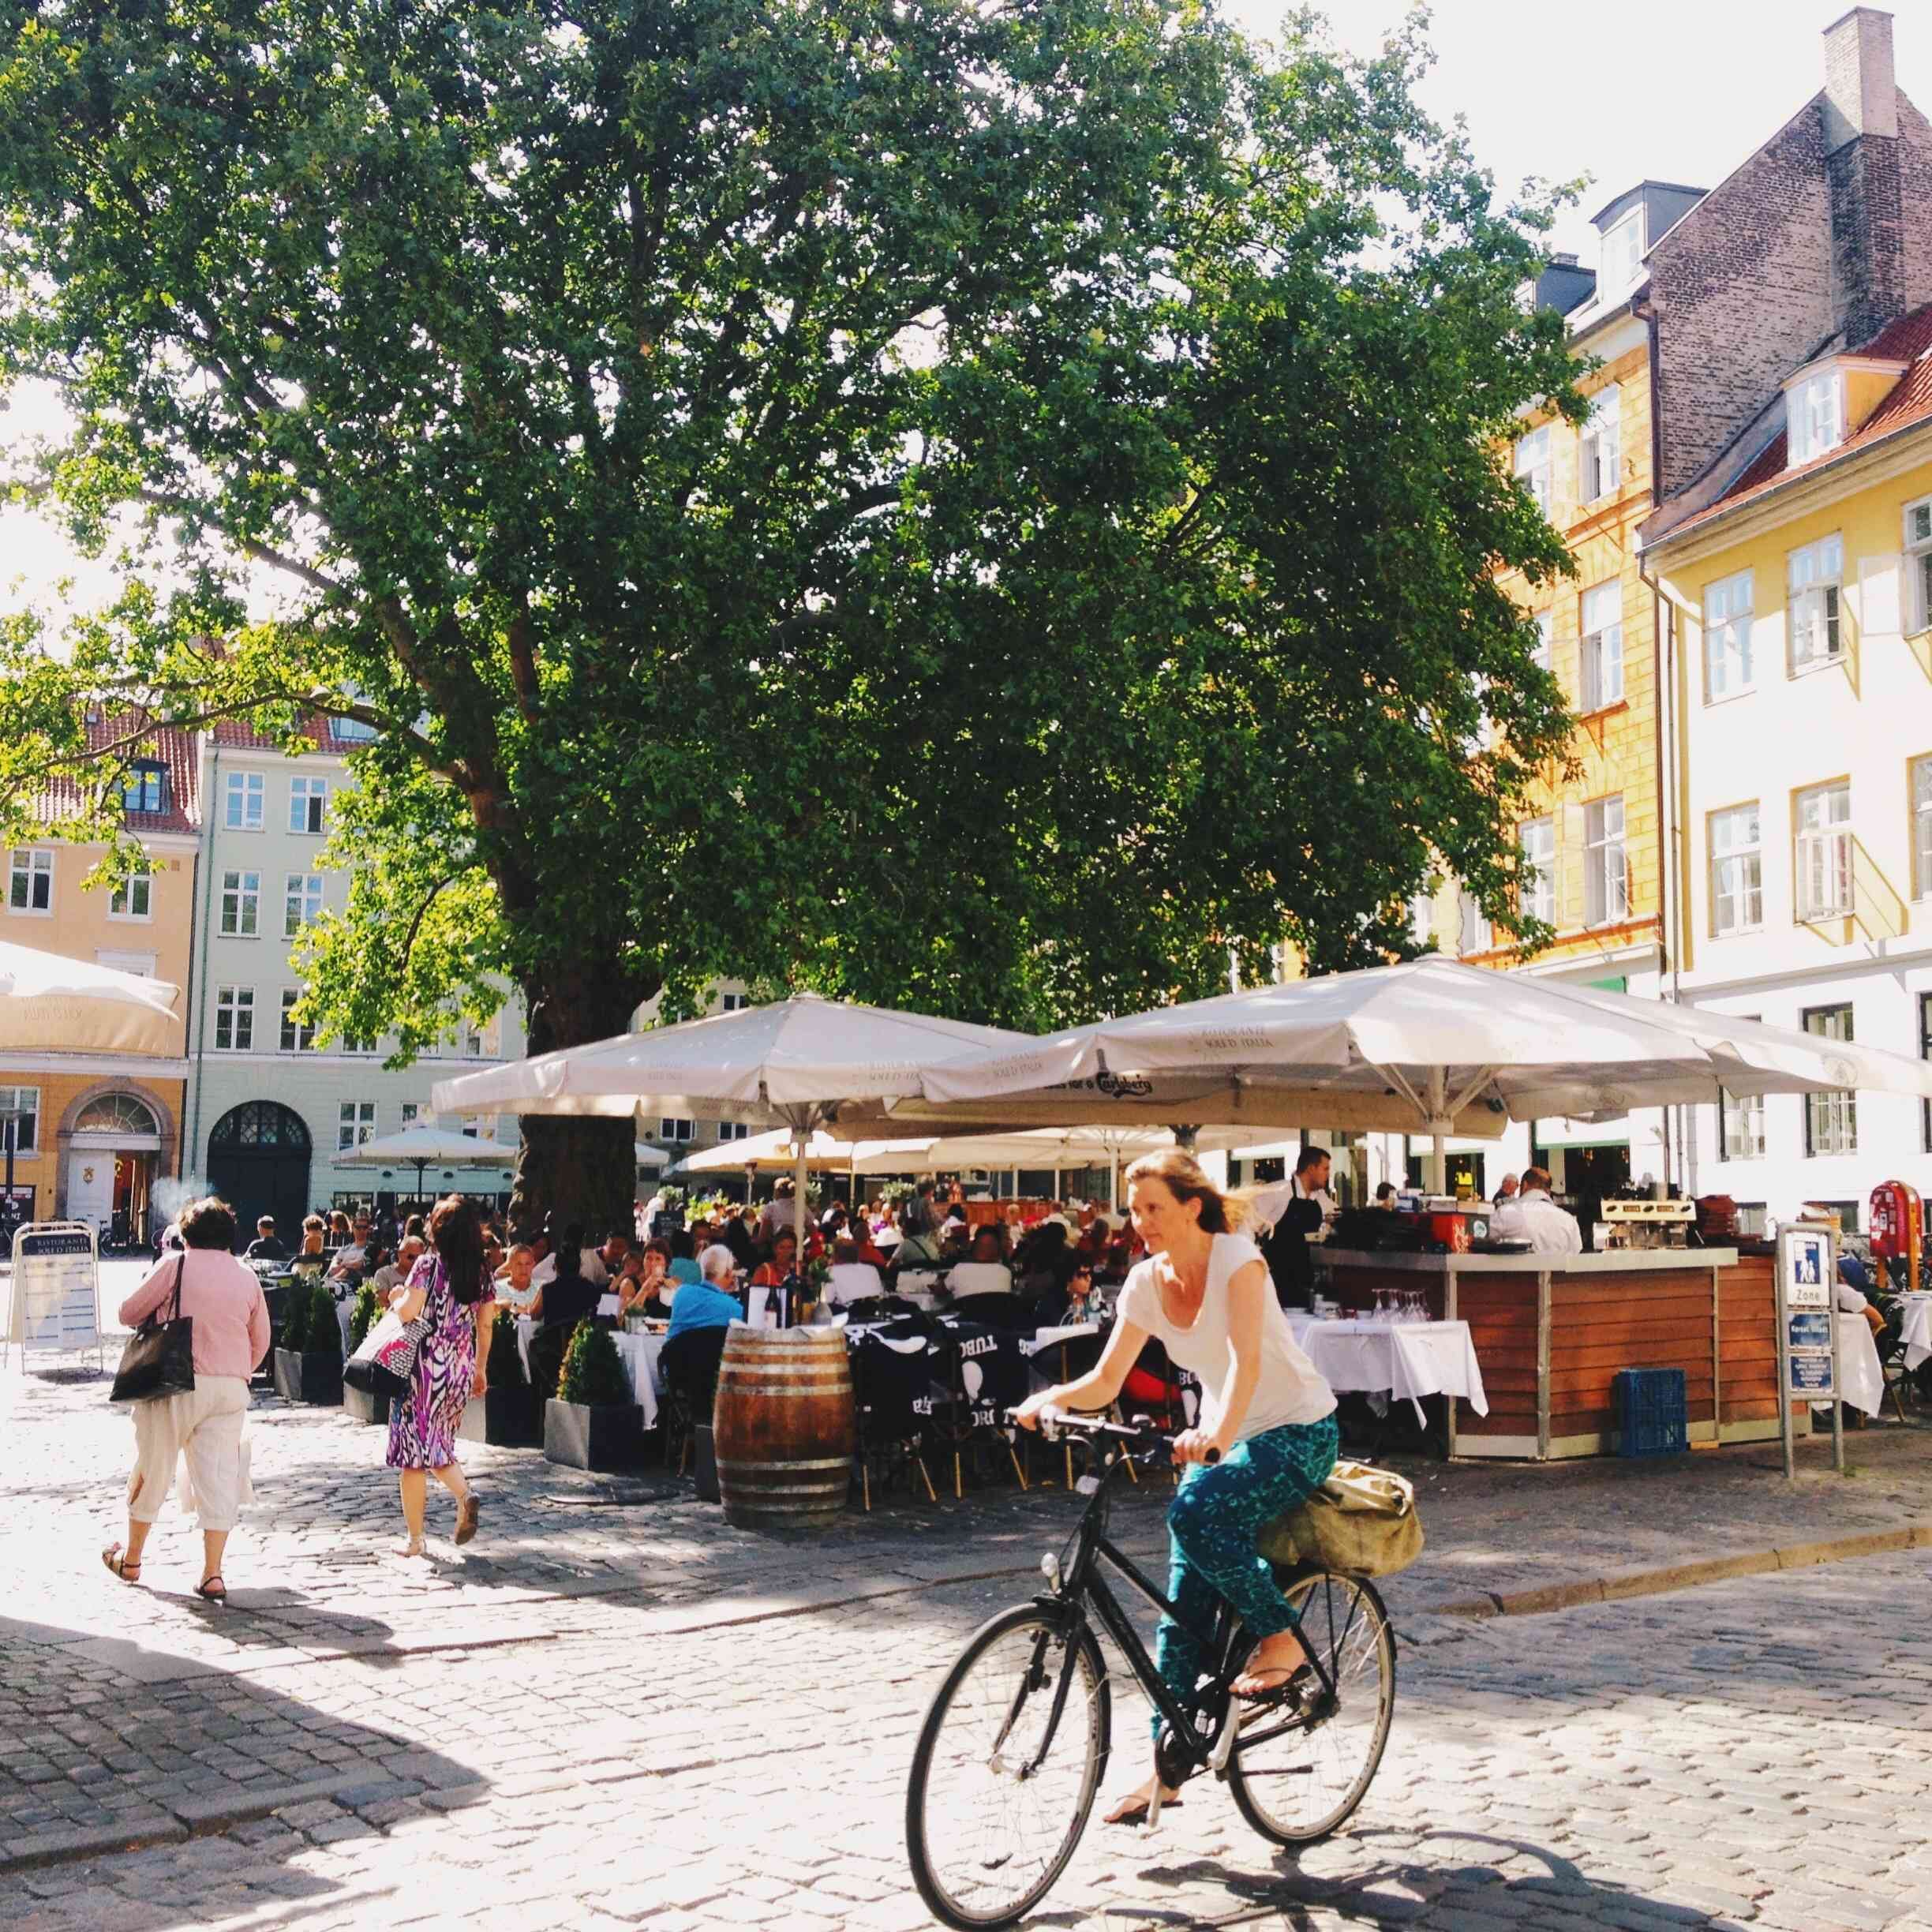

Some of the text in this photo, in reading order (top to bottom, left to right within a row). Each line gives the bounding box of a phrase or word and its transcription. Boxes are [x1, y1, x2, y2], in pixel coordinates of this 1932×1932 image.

[1096, 1071, 1153, 1099] Carlsberg
[37, 1237, 88, 1246] RISTORANTE
[1795, 1289, 1819, 1301] Zone
